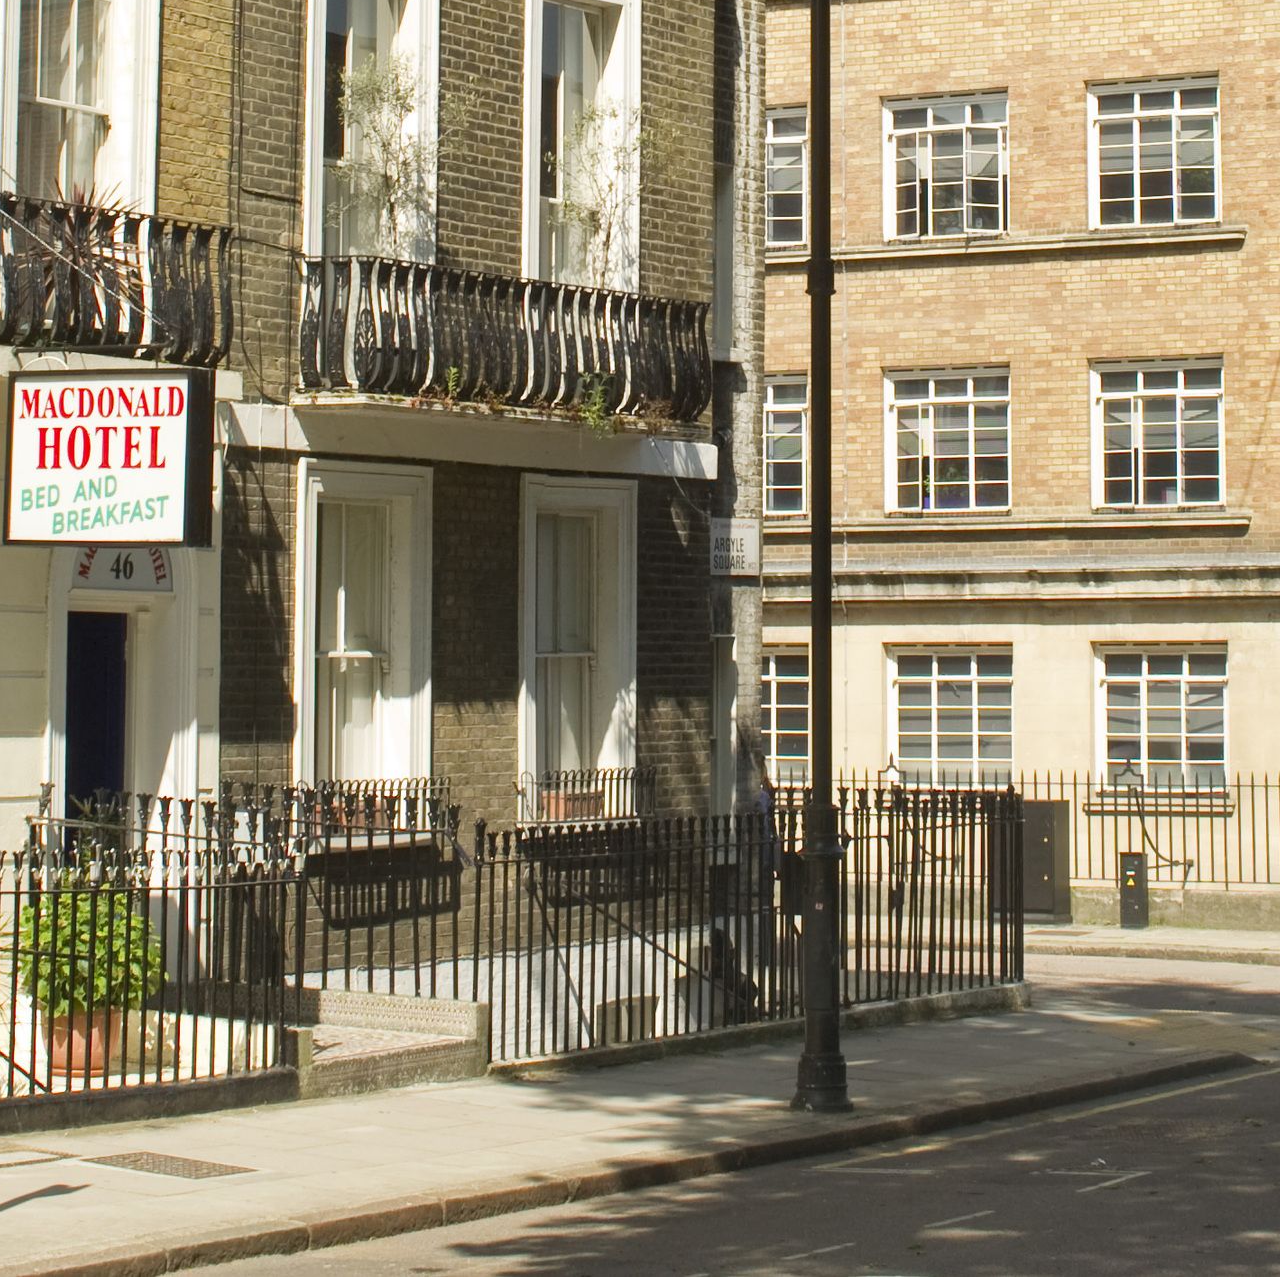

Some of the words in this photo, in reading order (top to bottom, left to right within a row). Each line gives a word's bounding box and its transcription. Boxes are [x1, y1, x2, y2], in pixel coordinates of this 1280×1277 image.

[19, 386, 185, 419] MACDONALD
[36, 425, 166, 470] HOTEL
[21, 484, 60, 512] BED
[73, 475, 117, 503] AND
[52, 495, 169, 534] BREAKFAST
[714, 537, 745, 553] ARGYLE
[110, 551, 134, 580] 46
[713, 554, 746, 570] SQUARE
